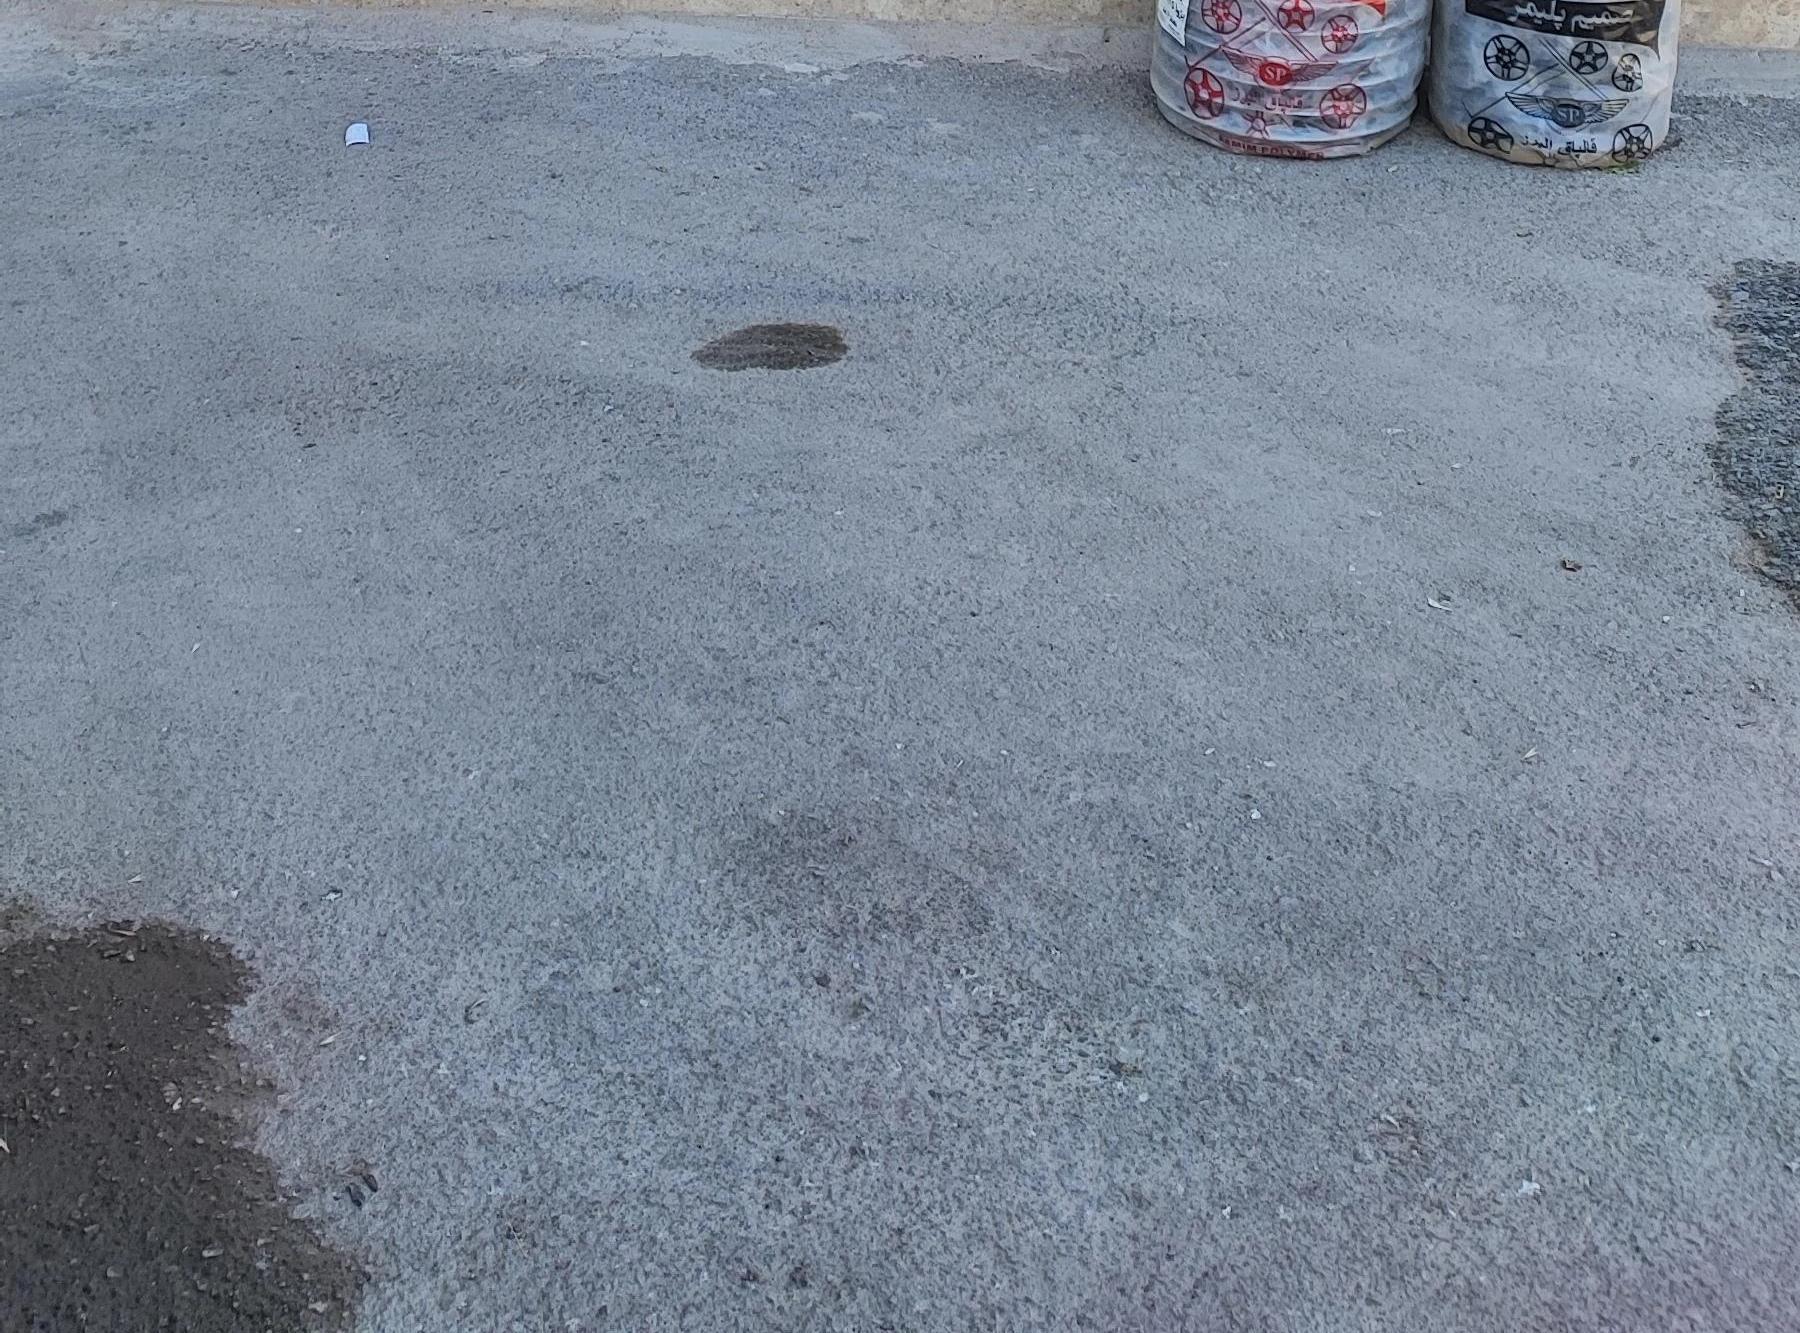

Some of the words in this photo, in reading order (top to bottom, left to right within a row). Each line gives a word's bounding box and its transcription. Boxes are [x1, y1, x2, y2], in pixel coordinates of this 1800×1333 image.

[1506, 0, 1567, 31] پلیمر
[1264, 67, 1286, 81] SP
[1557, 108, 1580, 122] SP
